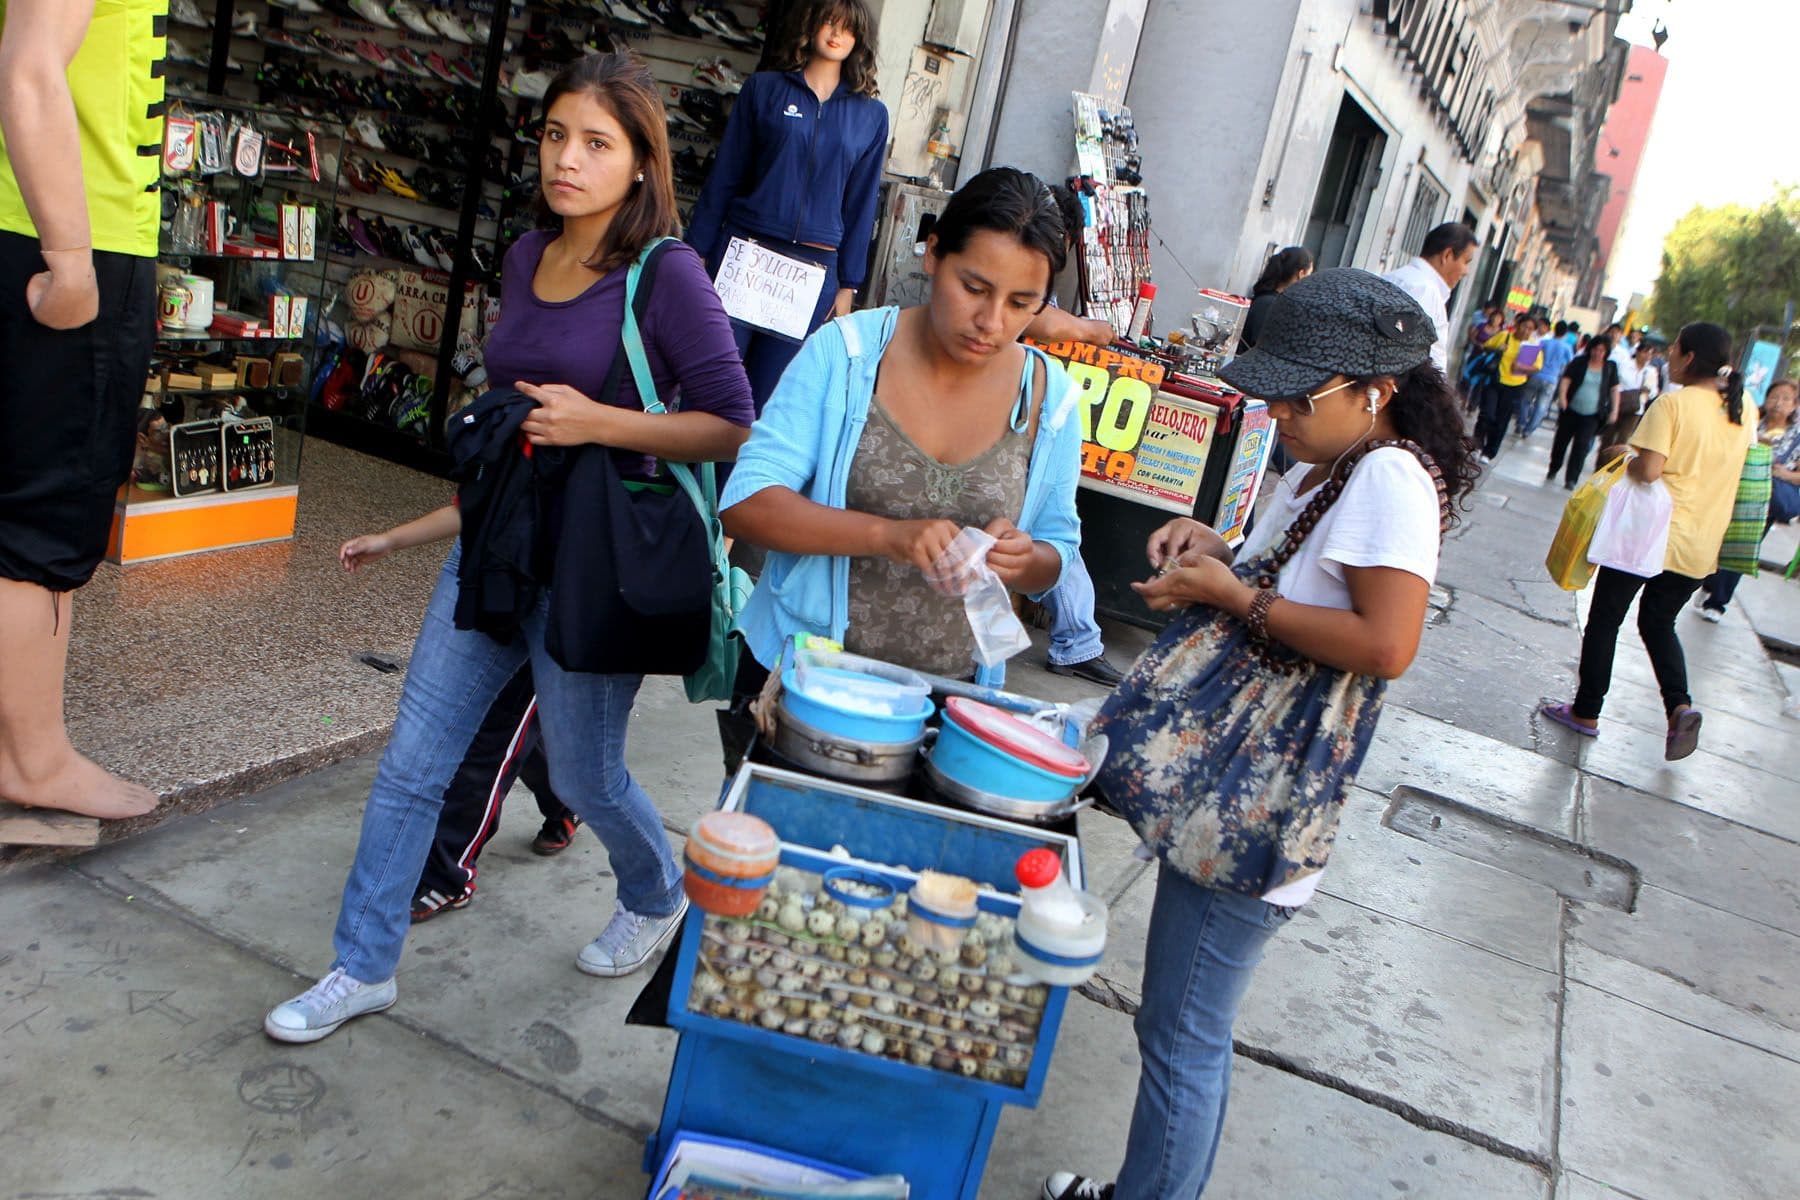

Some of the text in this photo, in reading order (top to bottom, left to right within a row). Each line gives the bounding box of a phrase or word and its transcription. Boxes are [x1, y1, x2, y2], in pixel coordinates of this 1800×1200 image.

[726, 240, 808, 287] SE SOLICITA
[1049, 355, 1152, 452] RO
[1150, 404, 1208, 445] RELOJERO
[1137, 469, 1185, 487] CON GARANTIA
